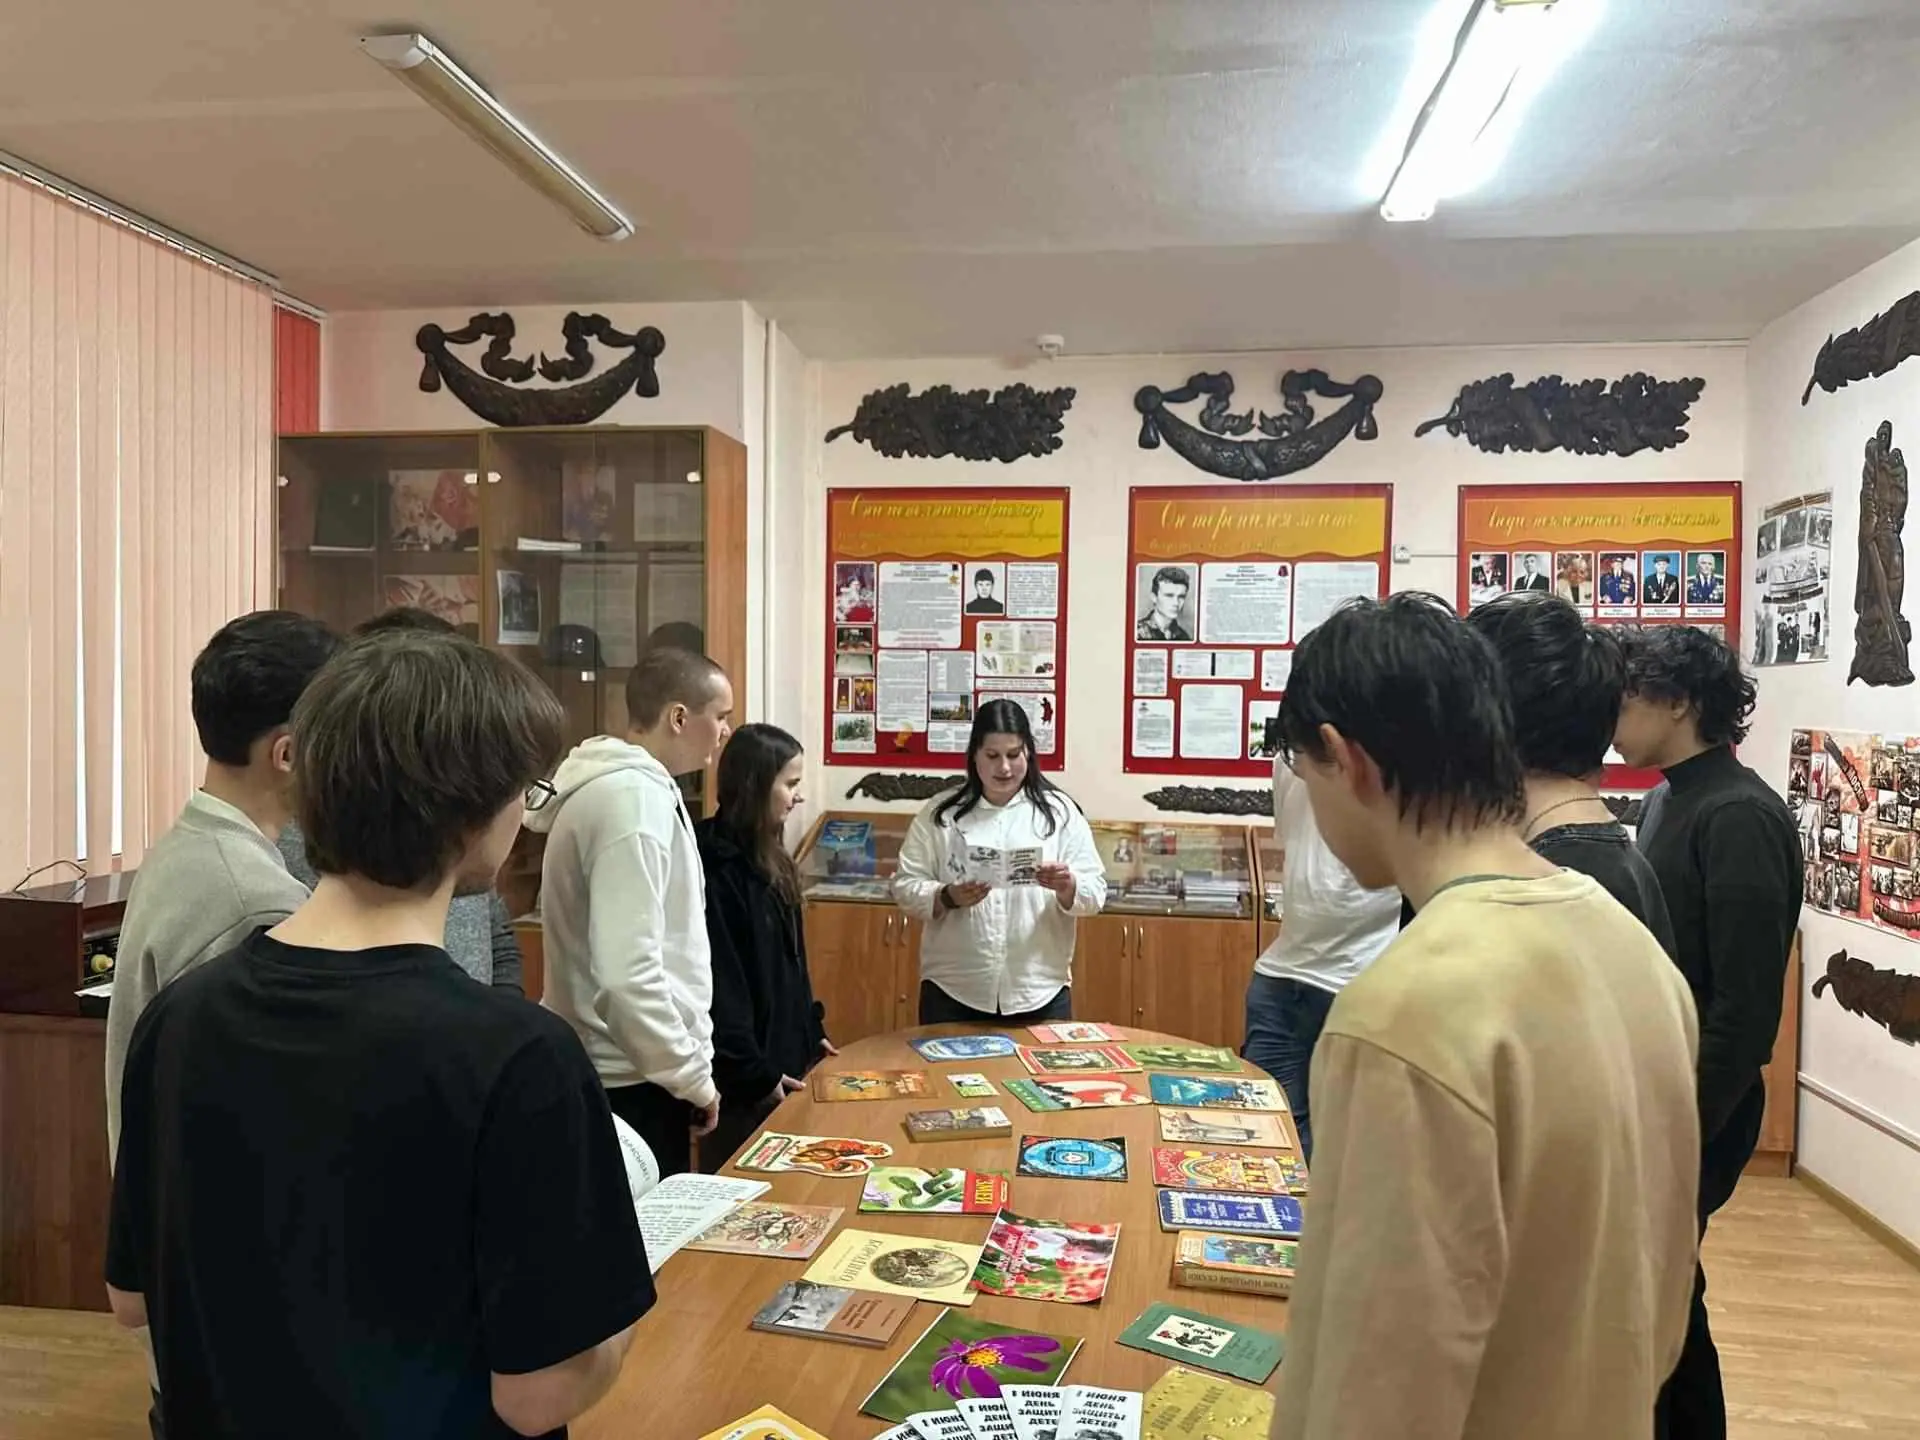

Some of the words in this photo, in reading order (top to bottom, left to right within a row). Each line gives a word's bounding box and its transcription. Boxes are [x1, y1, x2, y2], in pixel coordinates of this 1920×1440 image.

[1021, 1390, 1061, 1399] ИЮНЯ
[1086, 1391, 1128, 1403] ИЮНЯ
[978, 1404, 1008, 1412] ИЮН
[1024, 1400, 1055, 1408] ДЕНЬ
[1083, 1401, 1115, 1410] ДЕНЬ
[1072, 1408, 1126, 1421] ЗАЩИТЫ
[1028, 1418, 1058, 1426] ДЕТЕ
[1076, 1417, 1118, 1428] ДЕТЕЙ
[979, 1424, 1015, 1432] ЗАЩИ
